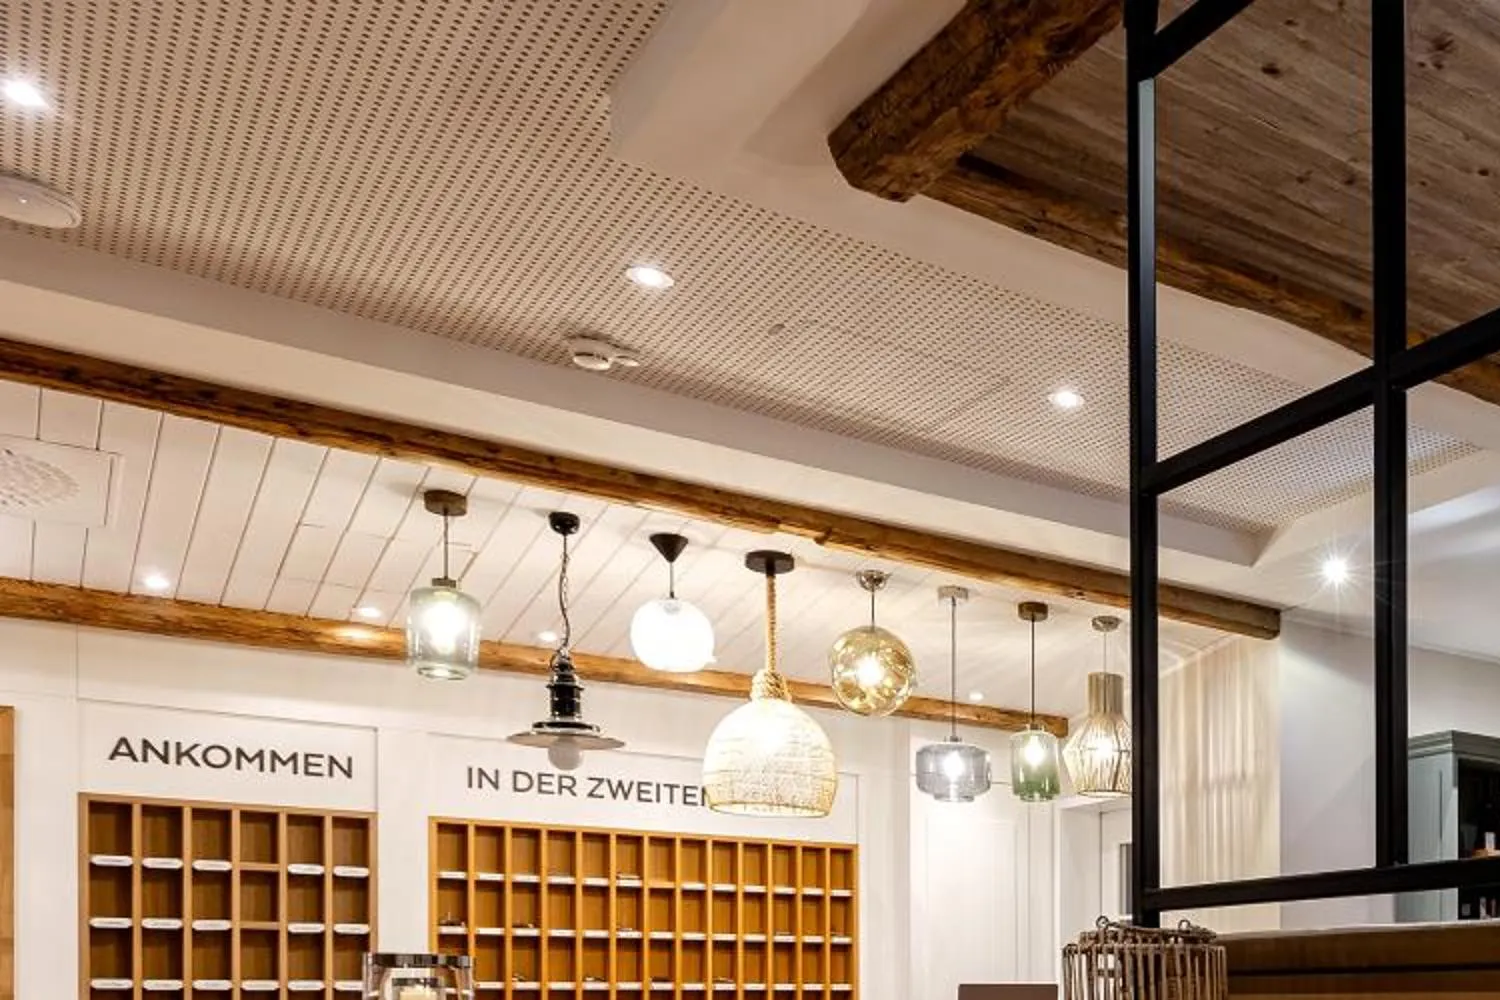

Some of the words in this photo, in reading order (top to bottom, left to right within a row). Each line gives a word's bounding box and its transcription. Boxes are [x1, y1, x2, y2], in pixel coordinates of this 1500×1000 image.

[108, 736, 353, 779] ANKOMMEN
[467, 766, 499, 790] IN
[512, 770, 577, 797] DER
